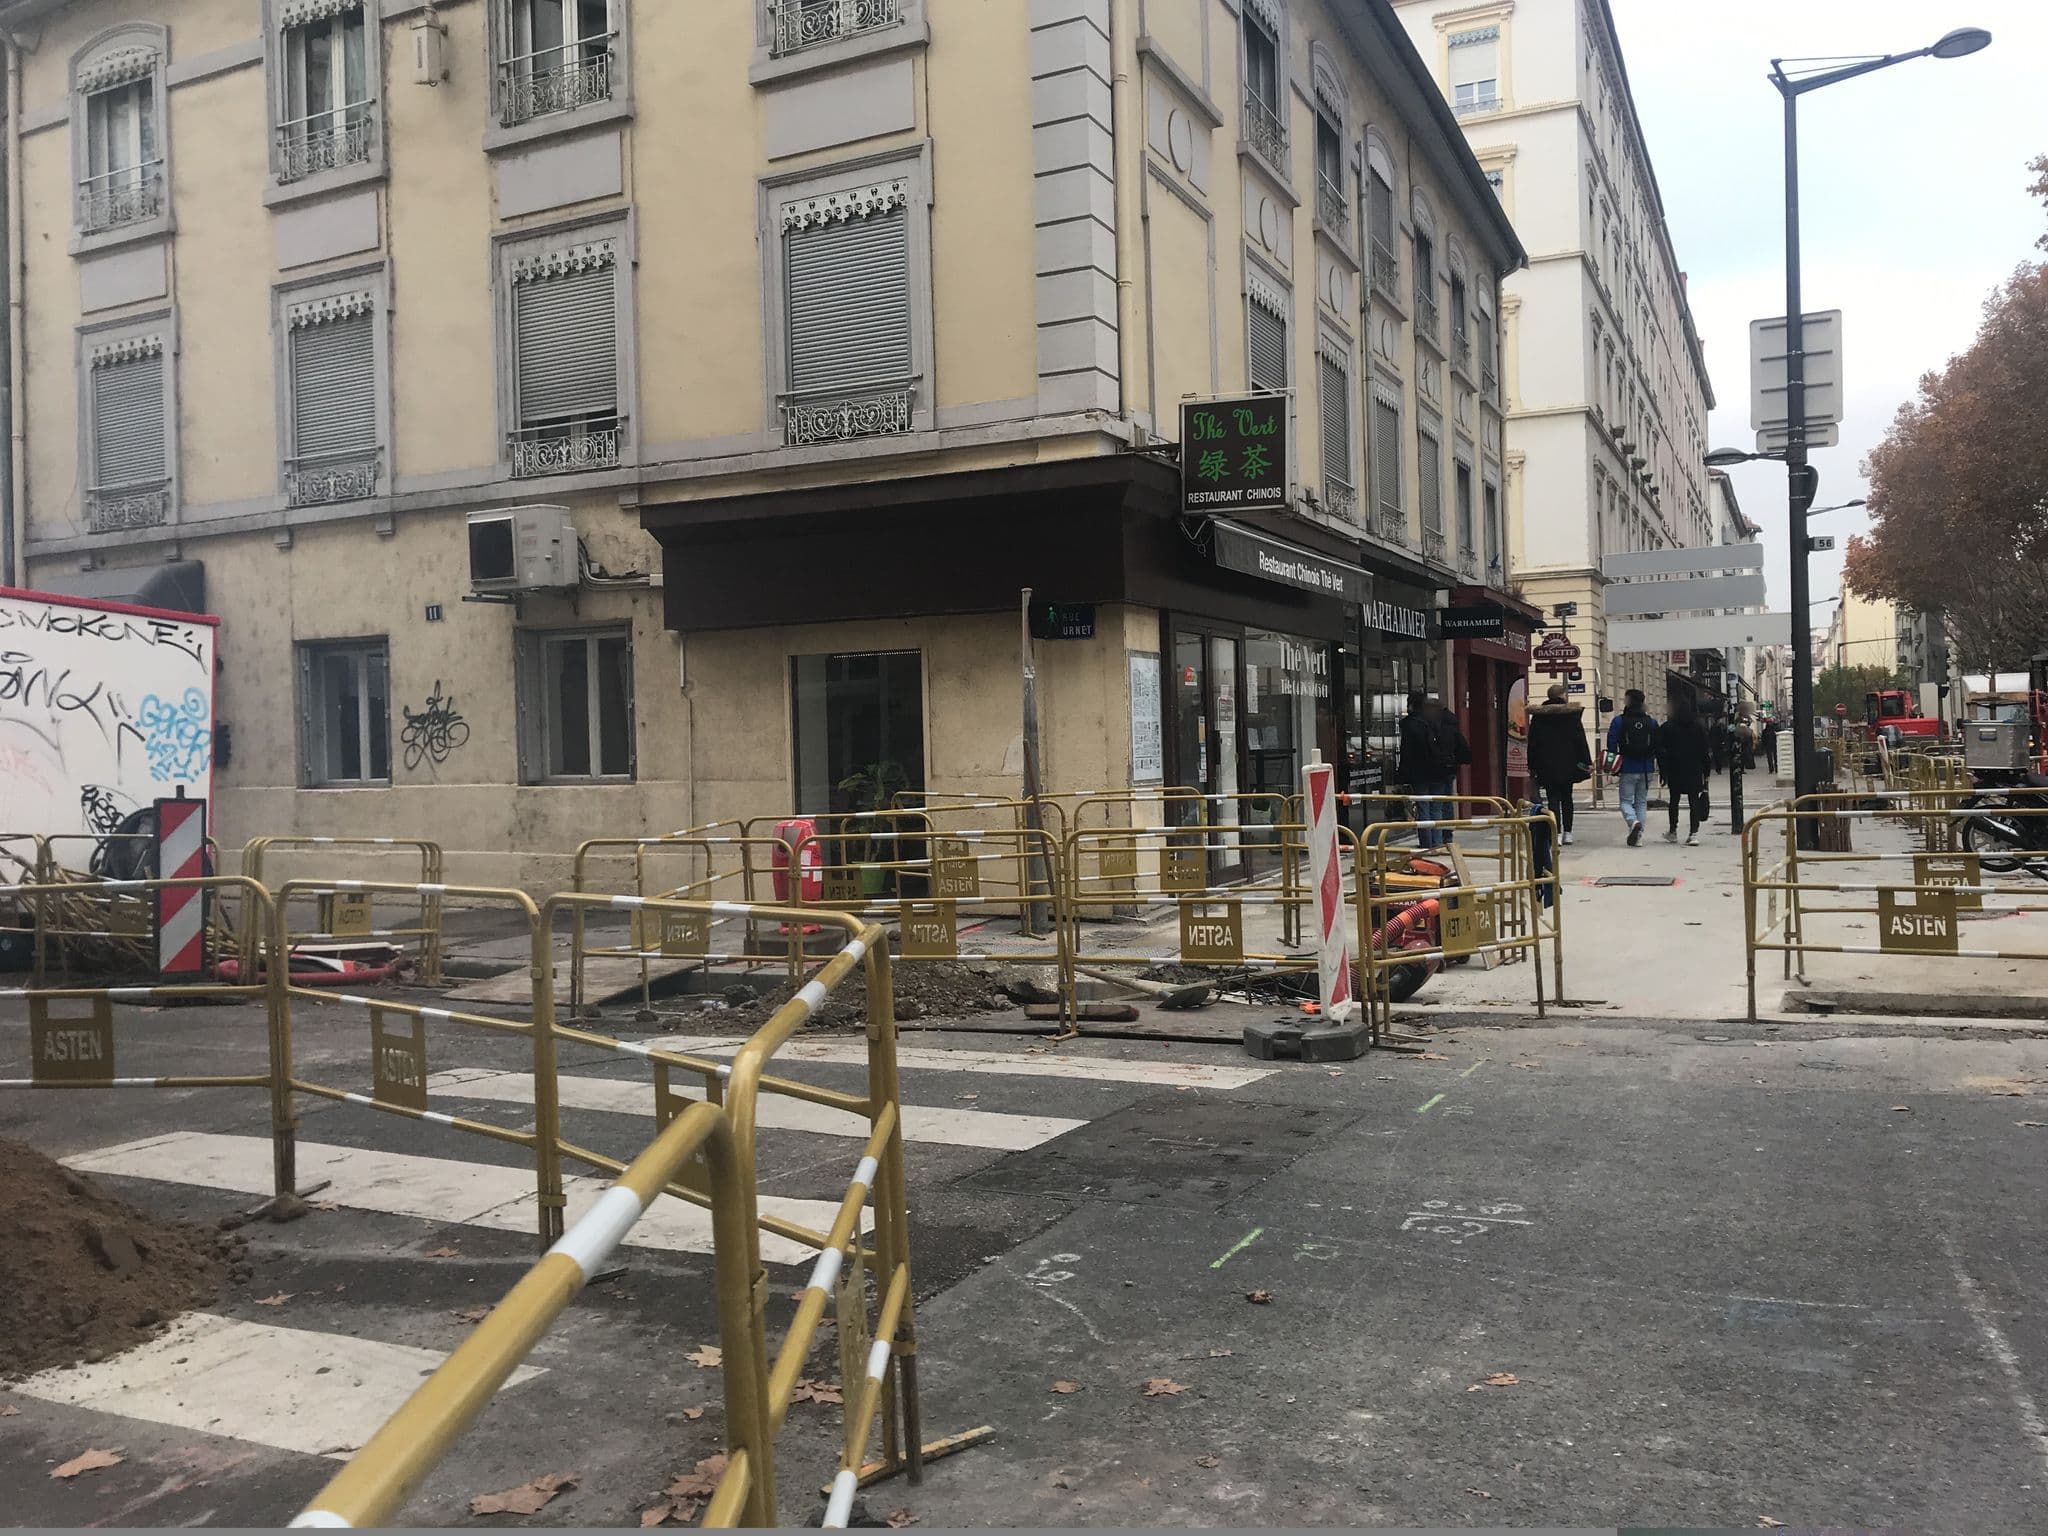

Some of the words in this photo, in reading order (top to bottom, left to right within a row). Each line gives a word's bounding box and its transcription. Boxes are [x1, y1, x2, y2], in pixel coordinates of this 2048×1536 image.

[1193, 411, 1227, 441] Thé
[1232, 408, 1278, 437] Vert
[1188, 489, 1243, 504] RESTAURANT
[1246, 486, 1282, 500] CHINOIS
[1819, 539, 1832, 547] 56
[1259, 550, 1297, 580] Restaurant
[1297, 562, 1320, 586] Chinois
[1320, 569, 1332, 589] Thé
[1332, 573, 1344, 592] Vert
[1362, 599, 1427, 639] WARHAMMER
[1444, 618, 1501, 628] WARHAMMER
[1278, 640, 1302, 672] Thé
[1303, 645, 1327, 676] Vert
[1538, 648, 1576, 657] BANETTE
[938, 876, 973, 894] ASTEN
[1890, 914, 1947, 937] ASTEN
[43, 1029, 104, 1062] ASTEN
